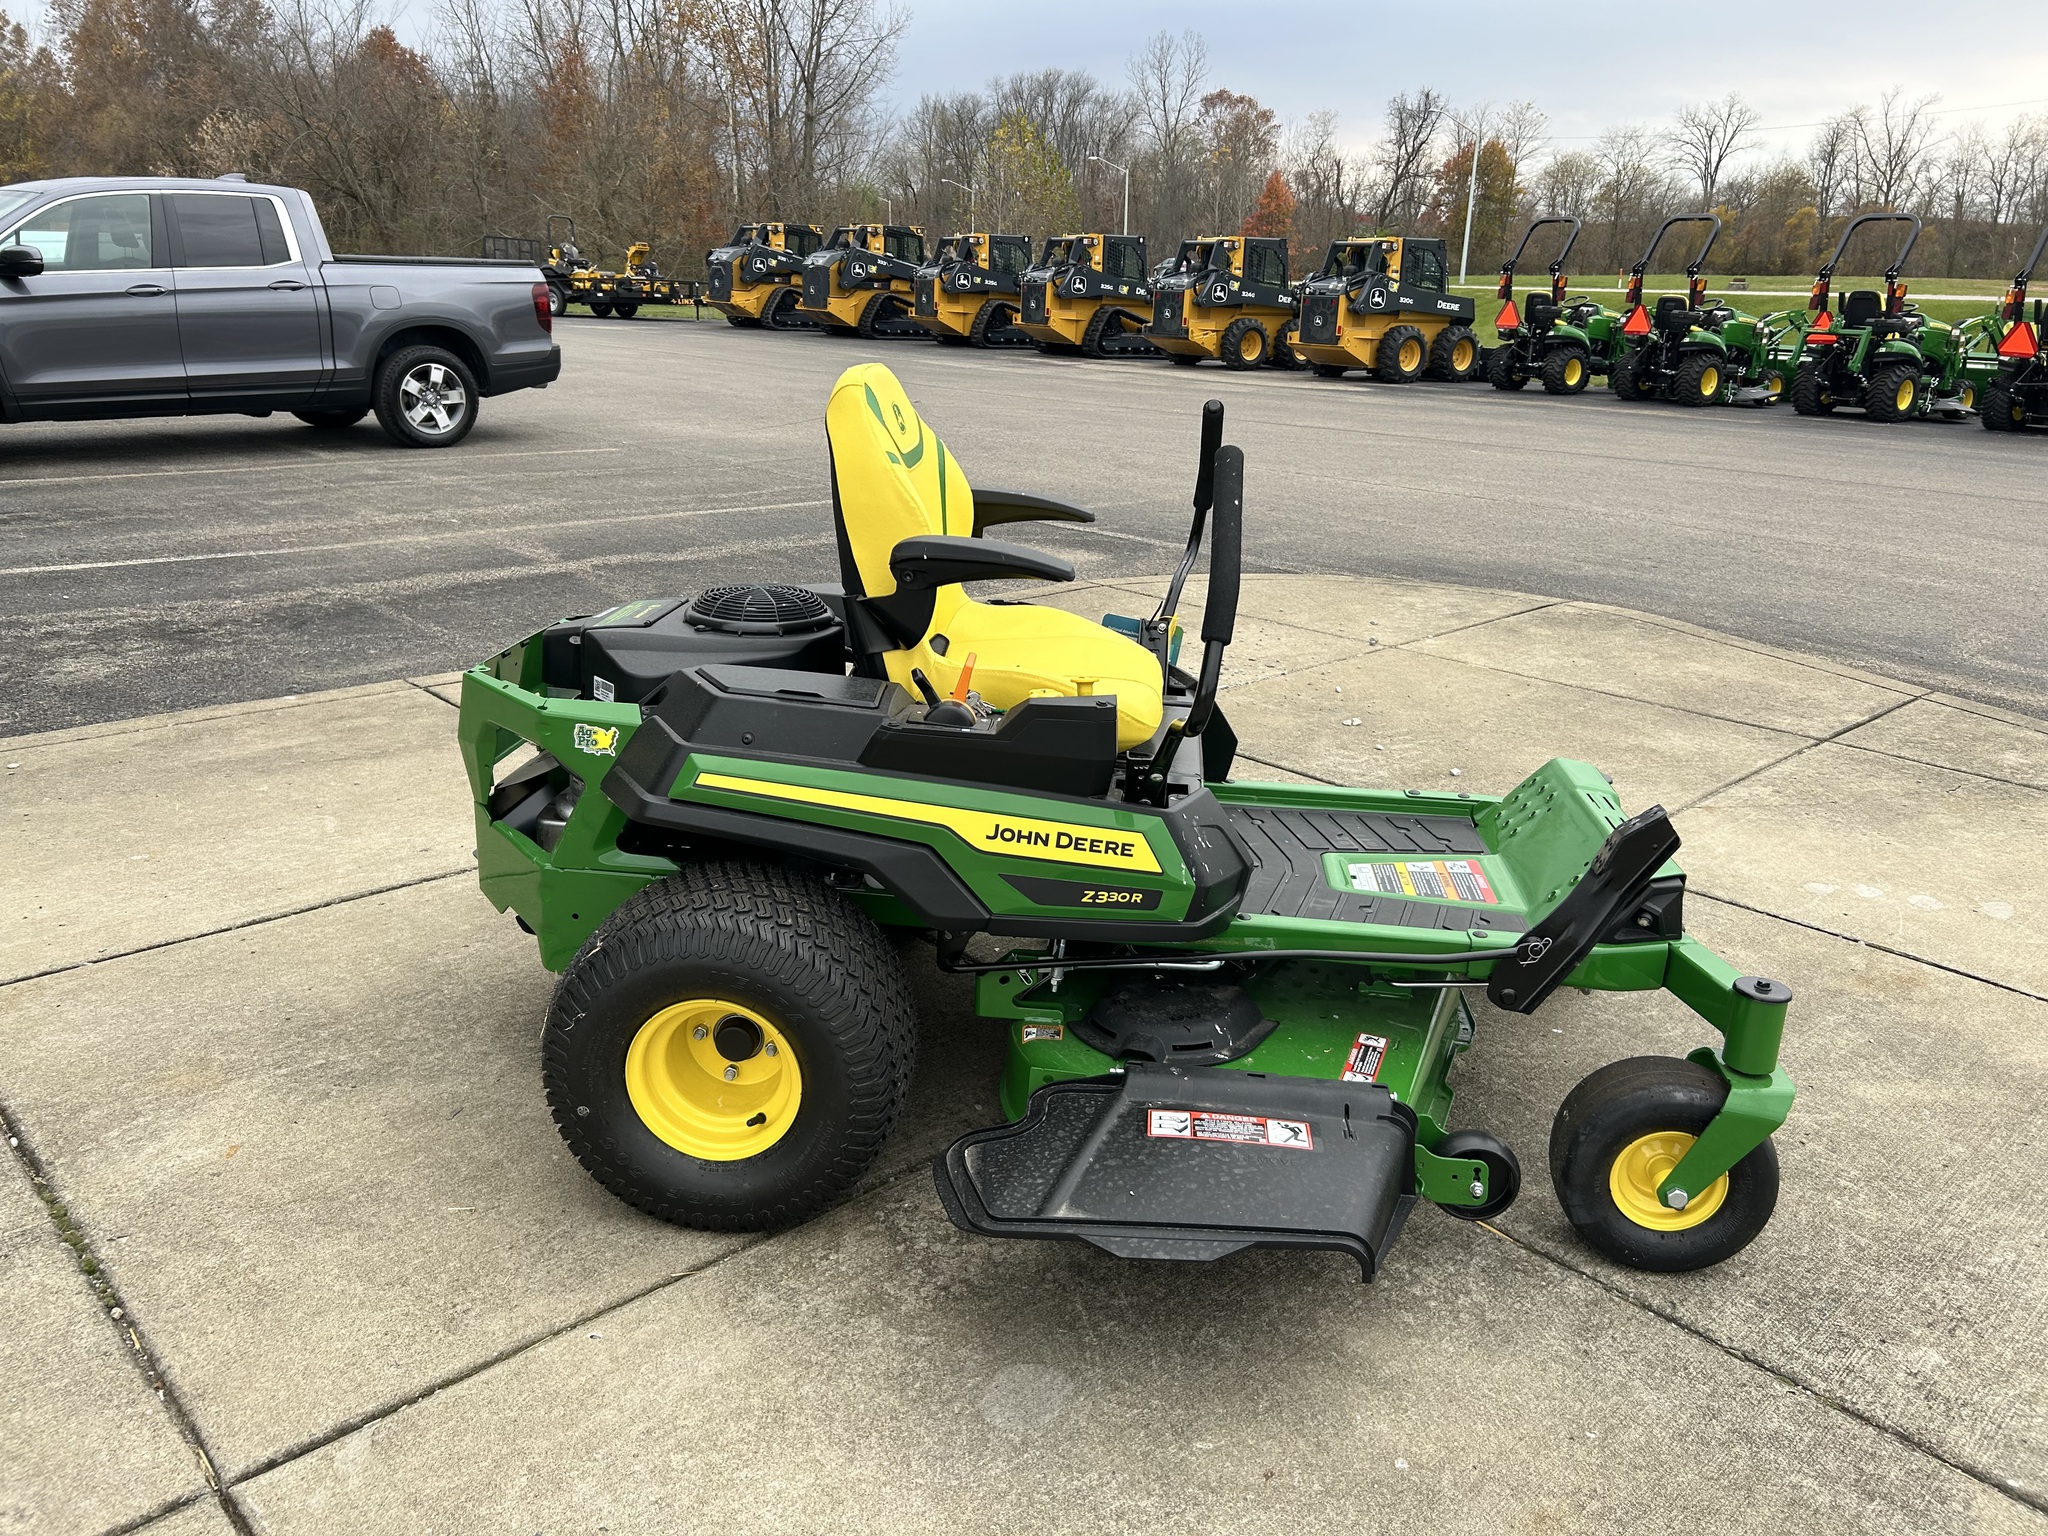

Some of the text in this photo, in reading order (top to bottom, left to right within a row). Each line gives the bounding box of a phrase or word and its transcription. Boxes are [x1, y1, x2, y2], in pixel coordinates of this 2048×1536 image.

[1277, 294, 1292, 304] DEE
[1436, 299, 1461, 311] DEERE
[577, 736, 598, 746] Pro
[985, 823, 1135, 858] JOHN DEERE
[1080, 890, 1143, 905] Z330R
[1211, 1113, 1258, 1123] DANGER
